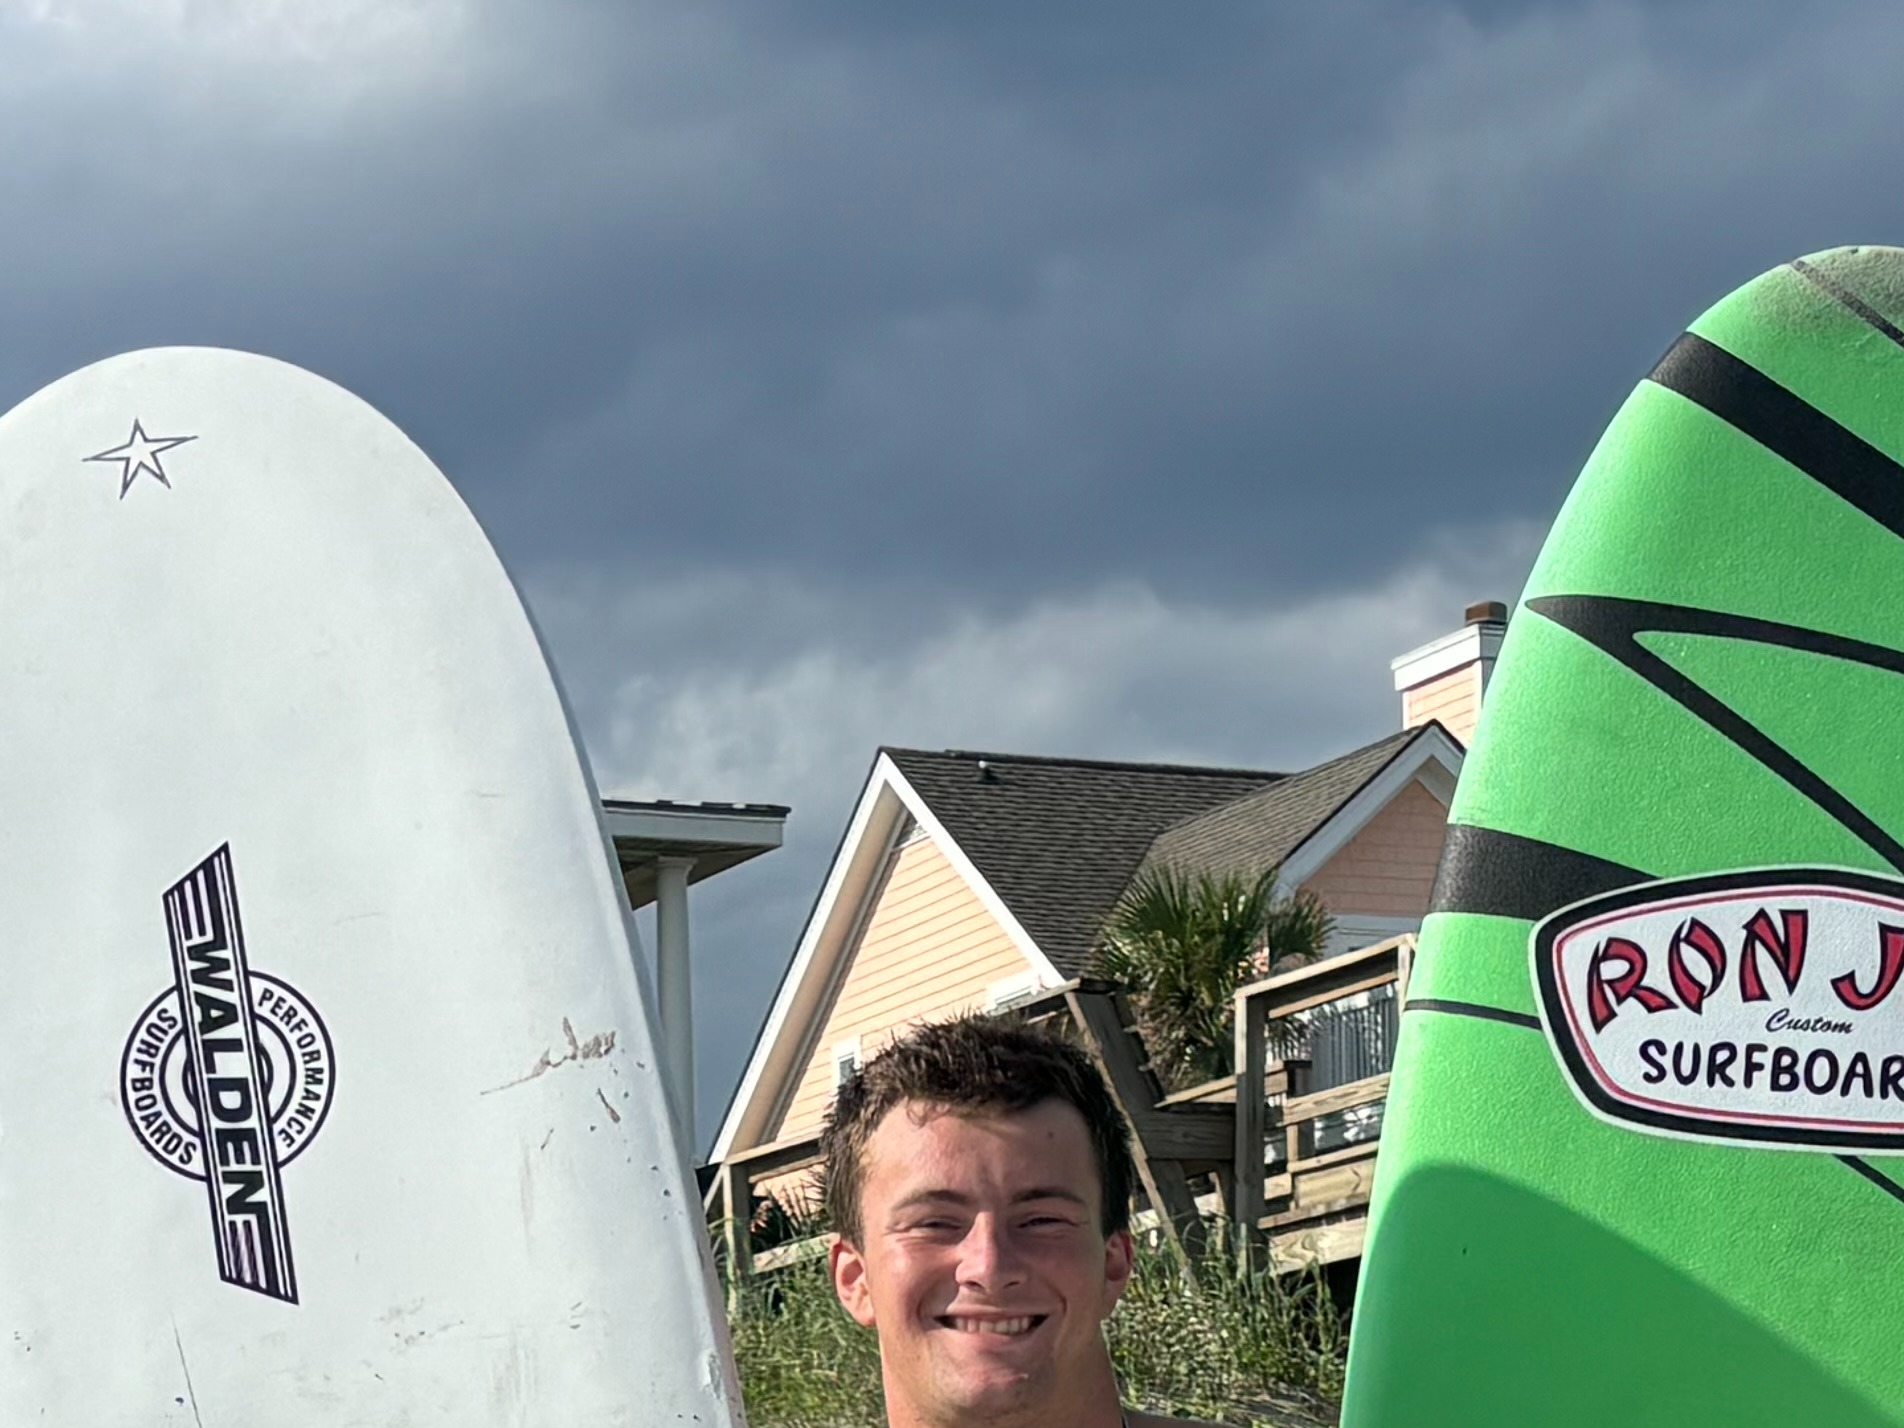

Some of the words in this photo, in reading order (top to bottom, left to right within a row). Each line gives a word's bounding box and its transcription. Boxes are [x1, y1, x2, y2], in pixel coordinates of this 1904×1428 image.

[1587, 907, 1809, 1035] RON
[1766, 1008, 1853, 1034] Custom
[130, 1008, 197, 1165] SURFBOARDS
[186, 937, 268, 1219] WALDEN
[257, 988, 325, 1148] PERFORMANCE
